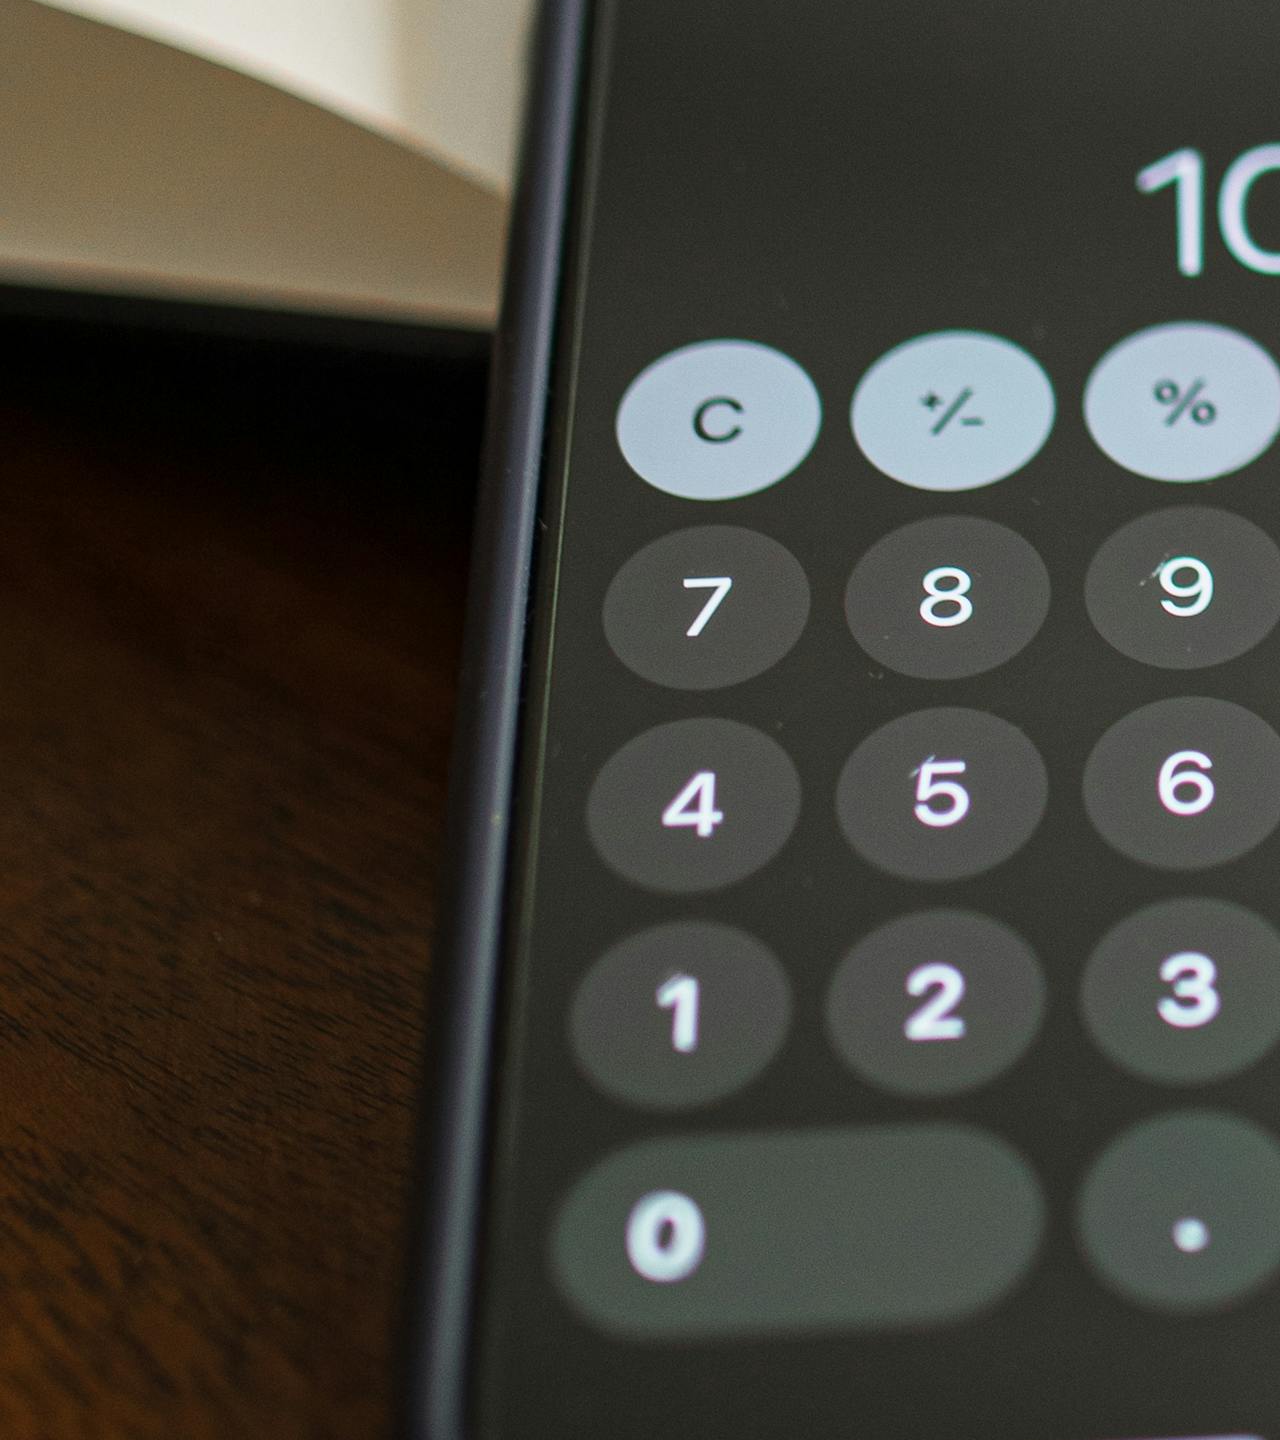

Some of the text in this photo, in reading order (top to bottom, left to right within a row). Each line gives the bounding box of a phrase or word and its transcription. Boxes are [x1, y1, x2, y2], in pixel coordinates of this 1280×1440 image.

[691, 396, 744, 445] C
[682, 575, 733, 638] 7
[918, 566, 974, 628] 8
[1156, 556, 1214, 618] 9
[661, 770, 724, 838] 4
[914, 758, 971, 828] 5
[1157, 749, 1216, 817] 6
[657, 975, 699, 1052] 1
[905, 962, 965, 1041] 2
[1158, 951, 1220, 1028] 3
[626, 1191, 705, 1282] 0
